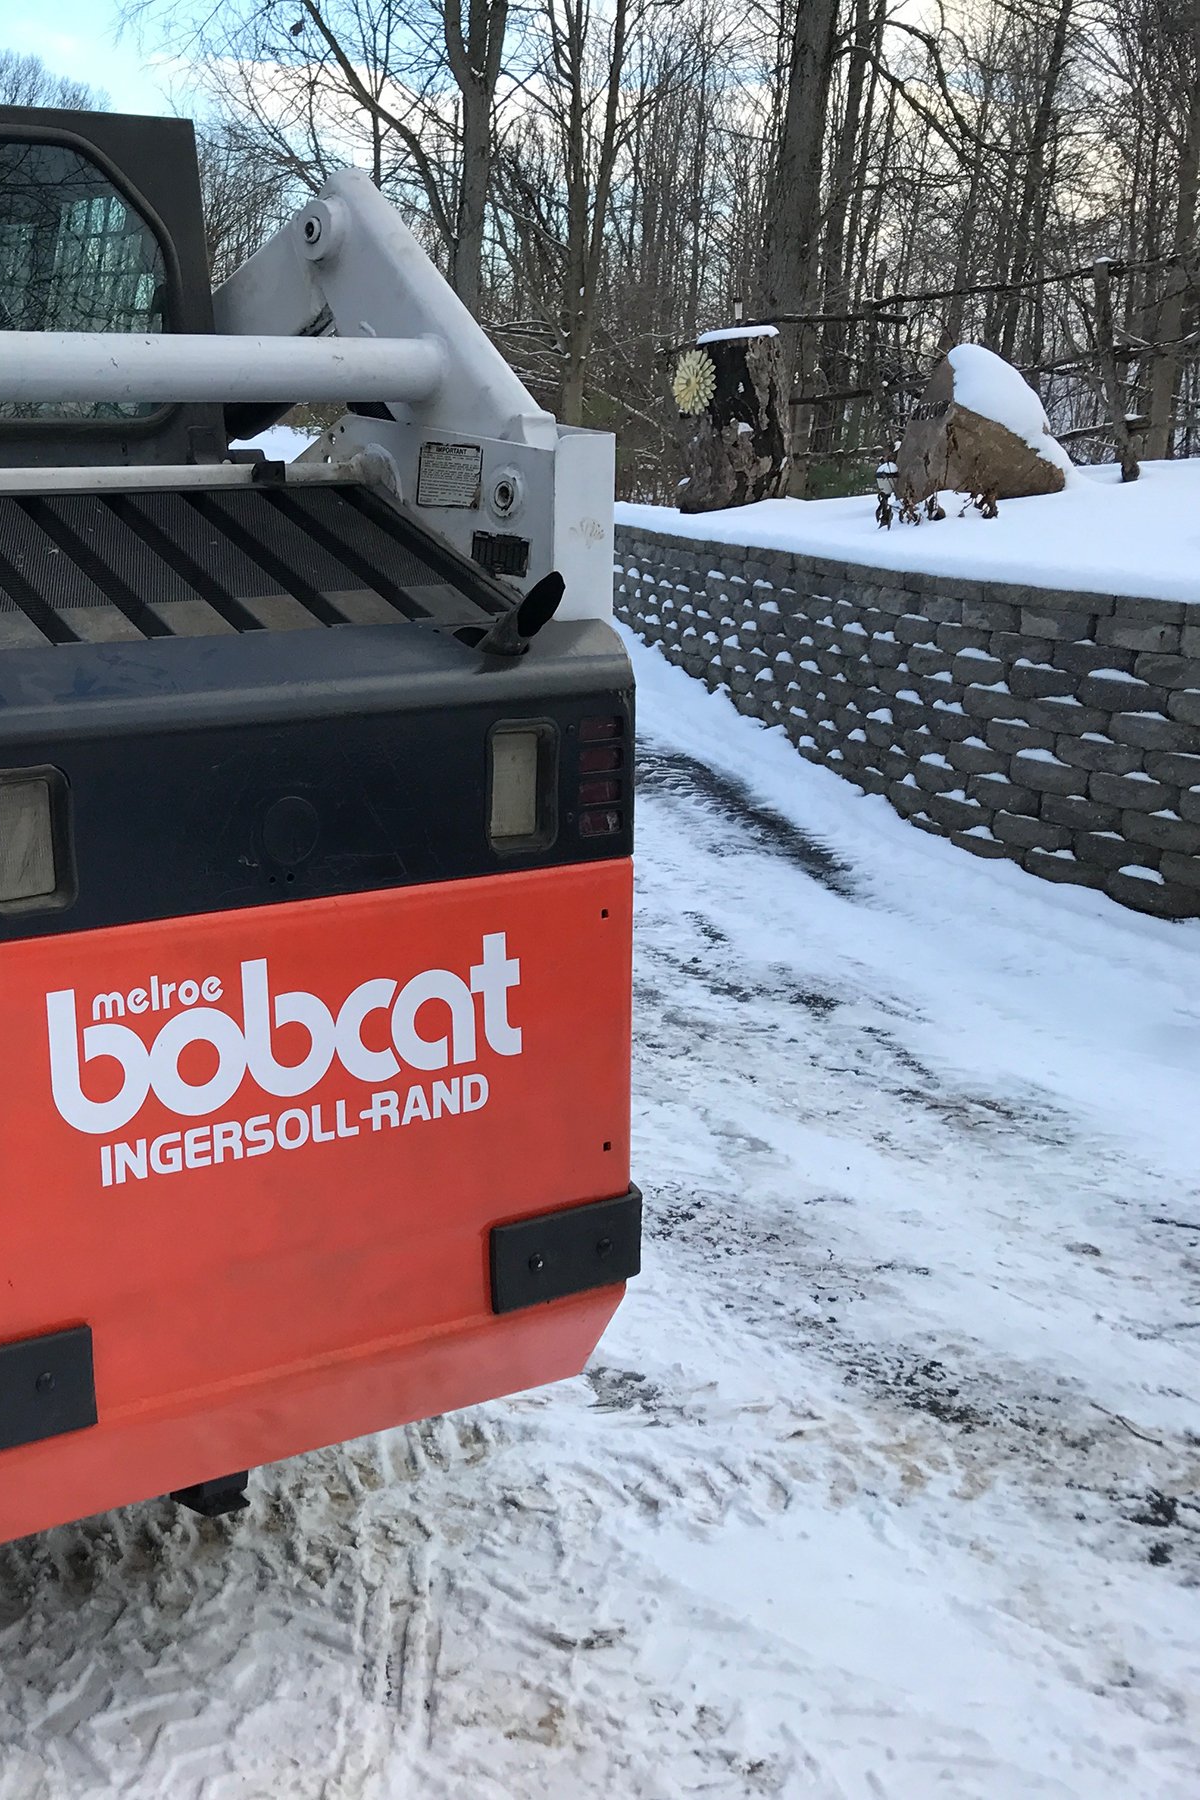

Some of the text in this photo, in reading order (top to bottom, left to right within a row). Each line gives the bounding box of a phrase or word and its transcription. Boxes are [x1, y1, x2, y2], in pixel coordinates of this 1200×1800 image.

[46, 931, 523, 1135] bobcat
[92, 975, 224, 1021] melroe
[100, 1073, 490, 1188] INGERSOLL-RAND
